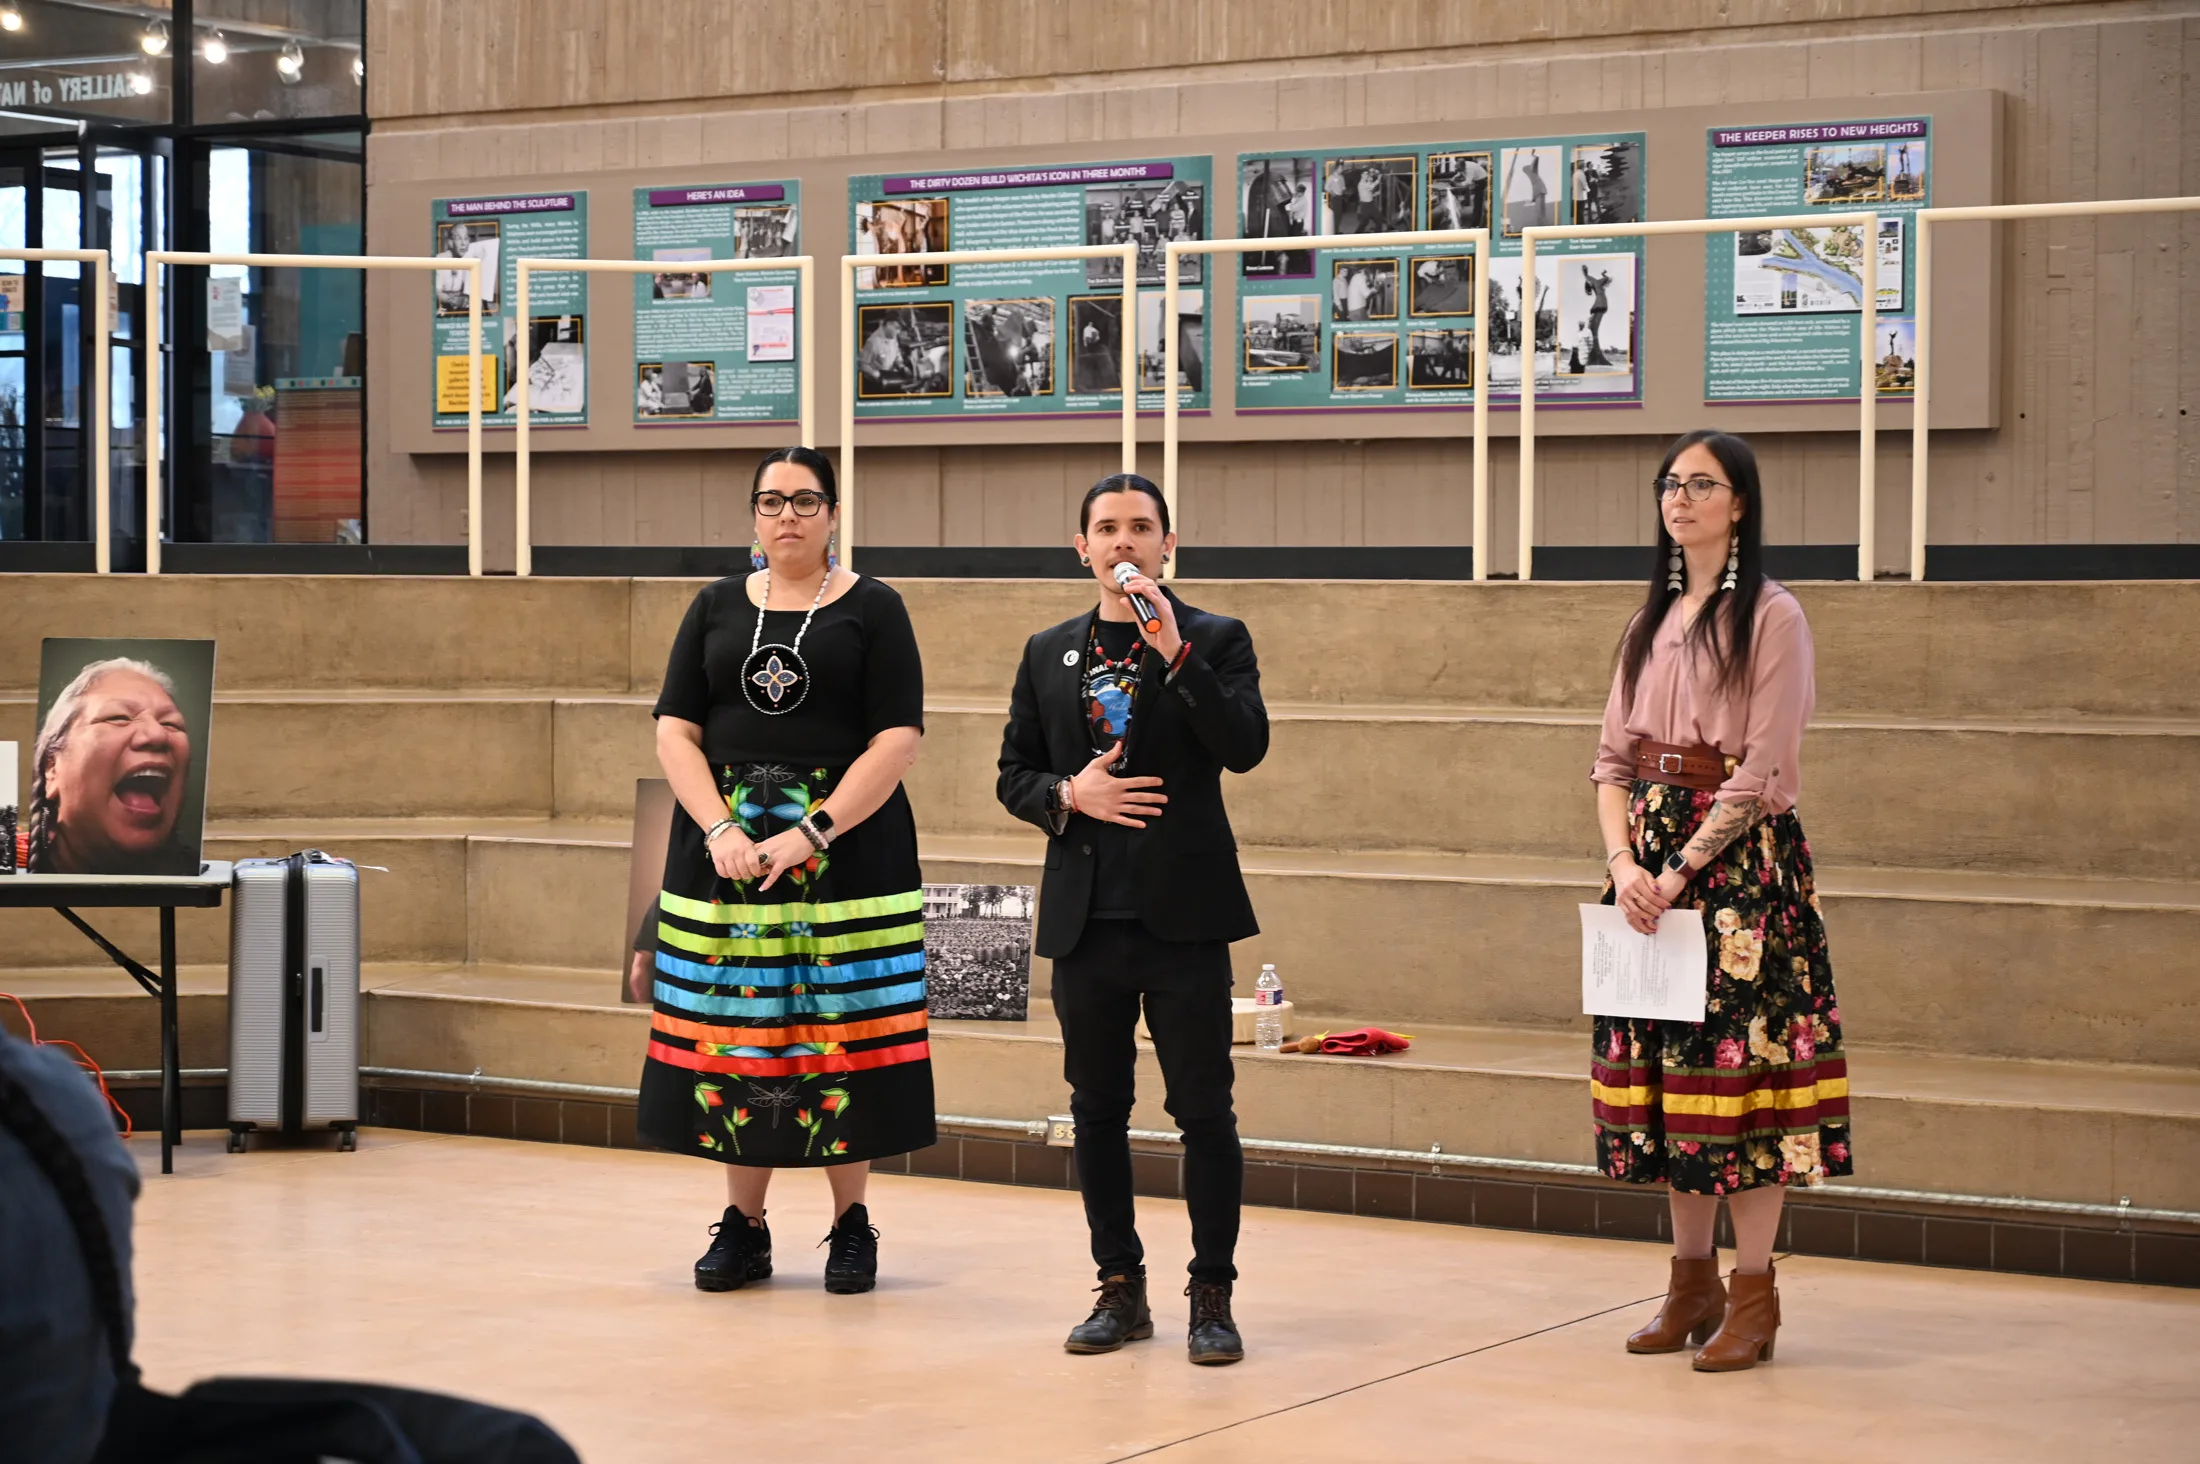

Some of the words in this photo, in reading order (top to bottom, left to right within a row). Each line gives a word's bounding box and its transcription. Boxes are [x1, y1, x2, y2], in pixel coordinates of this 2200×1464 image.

[1720, 132, 1741, 142] THE
[1744, 130, 1786, 141] KEEPER
[1789, 128, 1818, 139] RISES
[1822, 127, 1837, 137] TO
[1840, 126, 1867, 136] NEW
[1870, 123, 1919, 134] HEIGHTS
[910, 179, 926, 188] THE
[927, 178, 951, 188] DIRTY
[952, 176, 980, 186] DOZEN
[981, 175, 1006, 184] BUILD
[1007, 171, 1048, 183] WICHITA'S
[1049, 171, 1070, 180] ICON
[1071, 170, 1081, 179] IN
[1082, 168, 1108, 178] THREE
[1110, 167, 1146, 177] MONTHS
[687, 190, 712, 200] HERE'S
[714, 190, 726, 199] AN
[727, 189, 745, 198] IDEA
[451, 203, 465, 212] THE
[466, 203, 482, 211] MAN
[484, 201, 511, 210] BEHIND
[512, 200, 526, 208] THE
[528, 198, 569, 208] SCULPTURE
